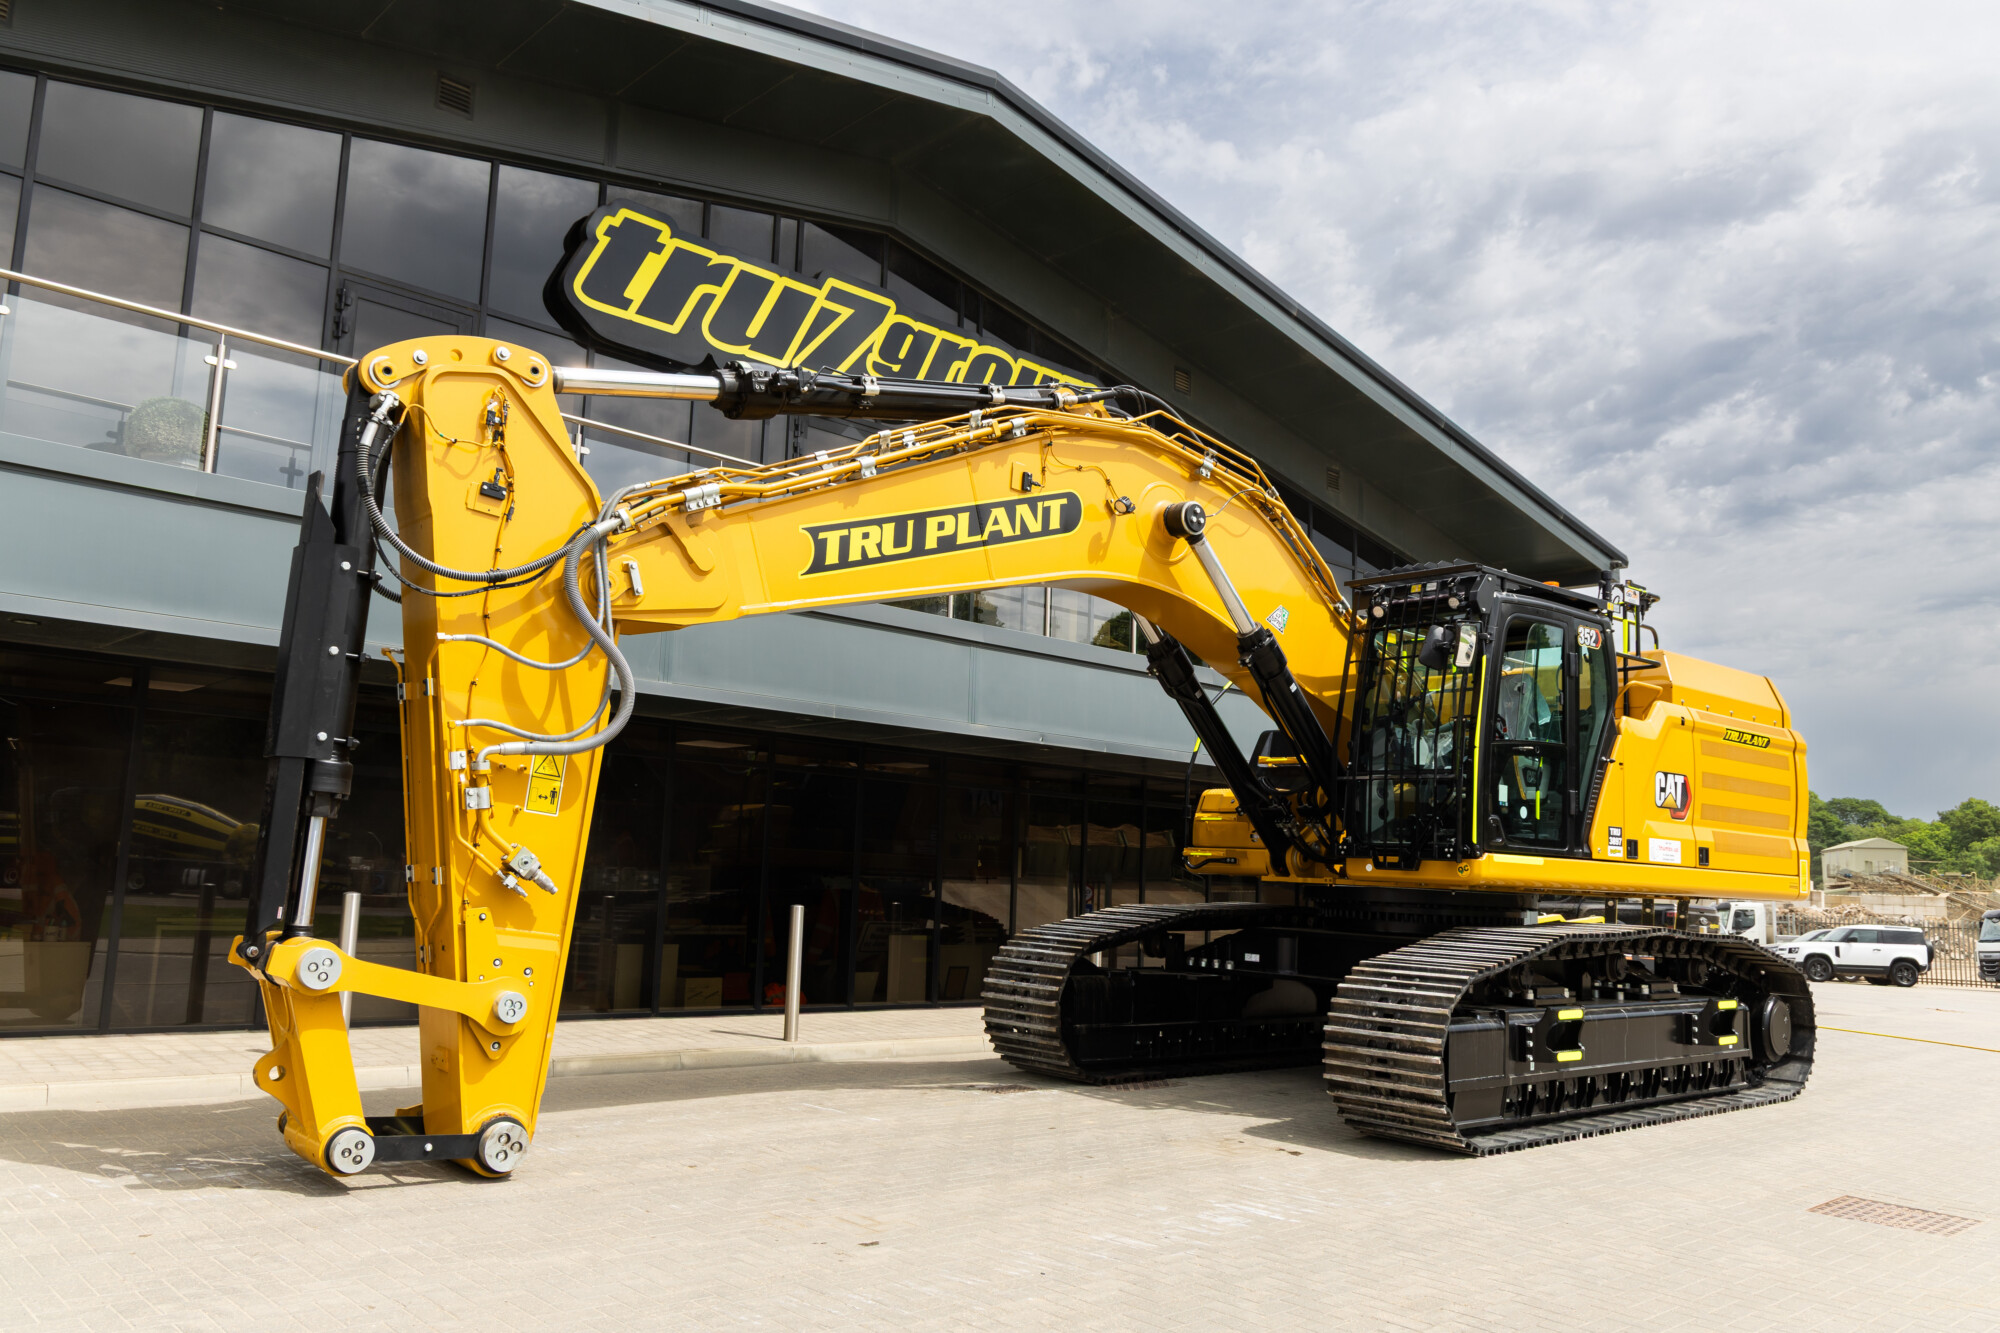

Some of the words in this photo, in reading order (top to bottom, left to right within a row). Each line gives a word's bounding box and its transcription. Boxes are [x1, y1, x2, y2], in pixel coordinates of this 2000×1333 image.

[818, 520, 914, 566] TRU
[924, 498, 1068, 550] PLANT
[1577, 626, 1597, 647] 352
[1724, 729, 1743, 742] TRU
[1740, 733, 1770, 748] PLANT
[1655, 771, 1685, 810] CAT
[1609, 827, 1621, 836] TRU
